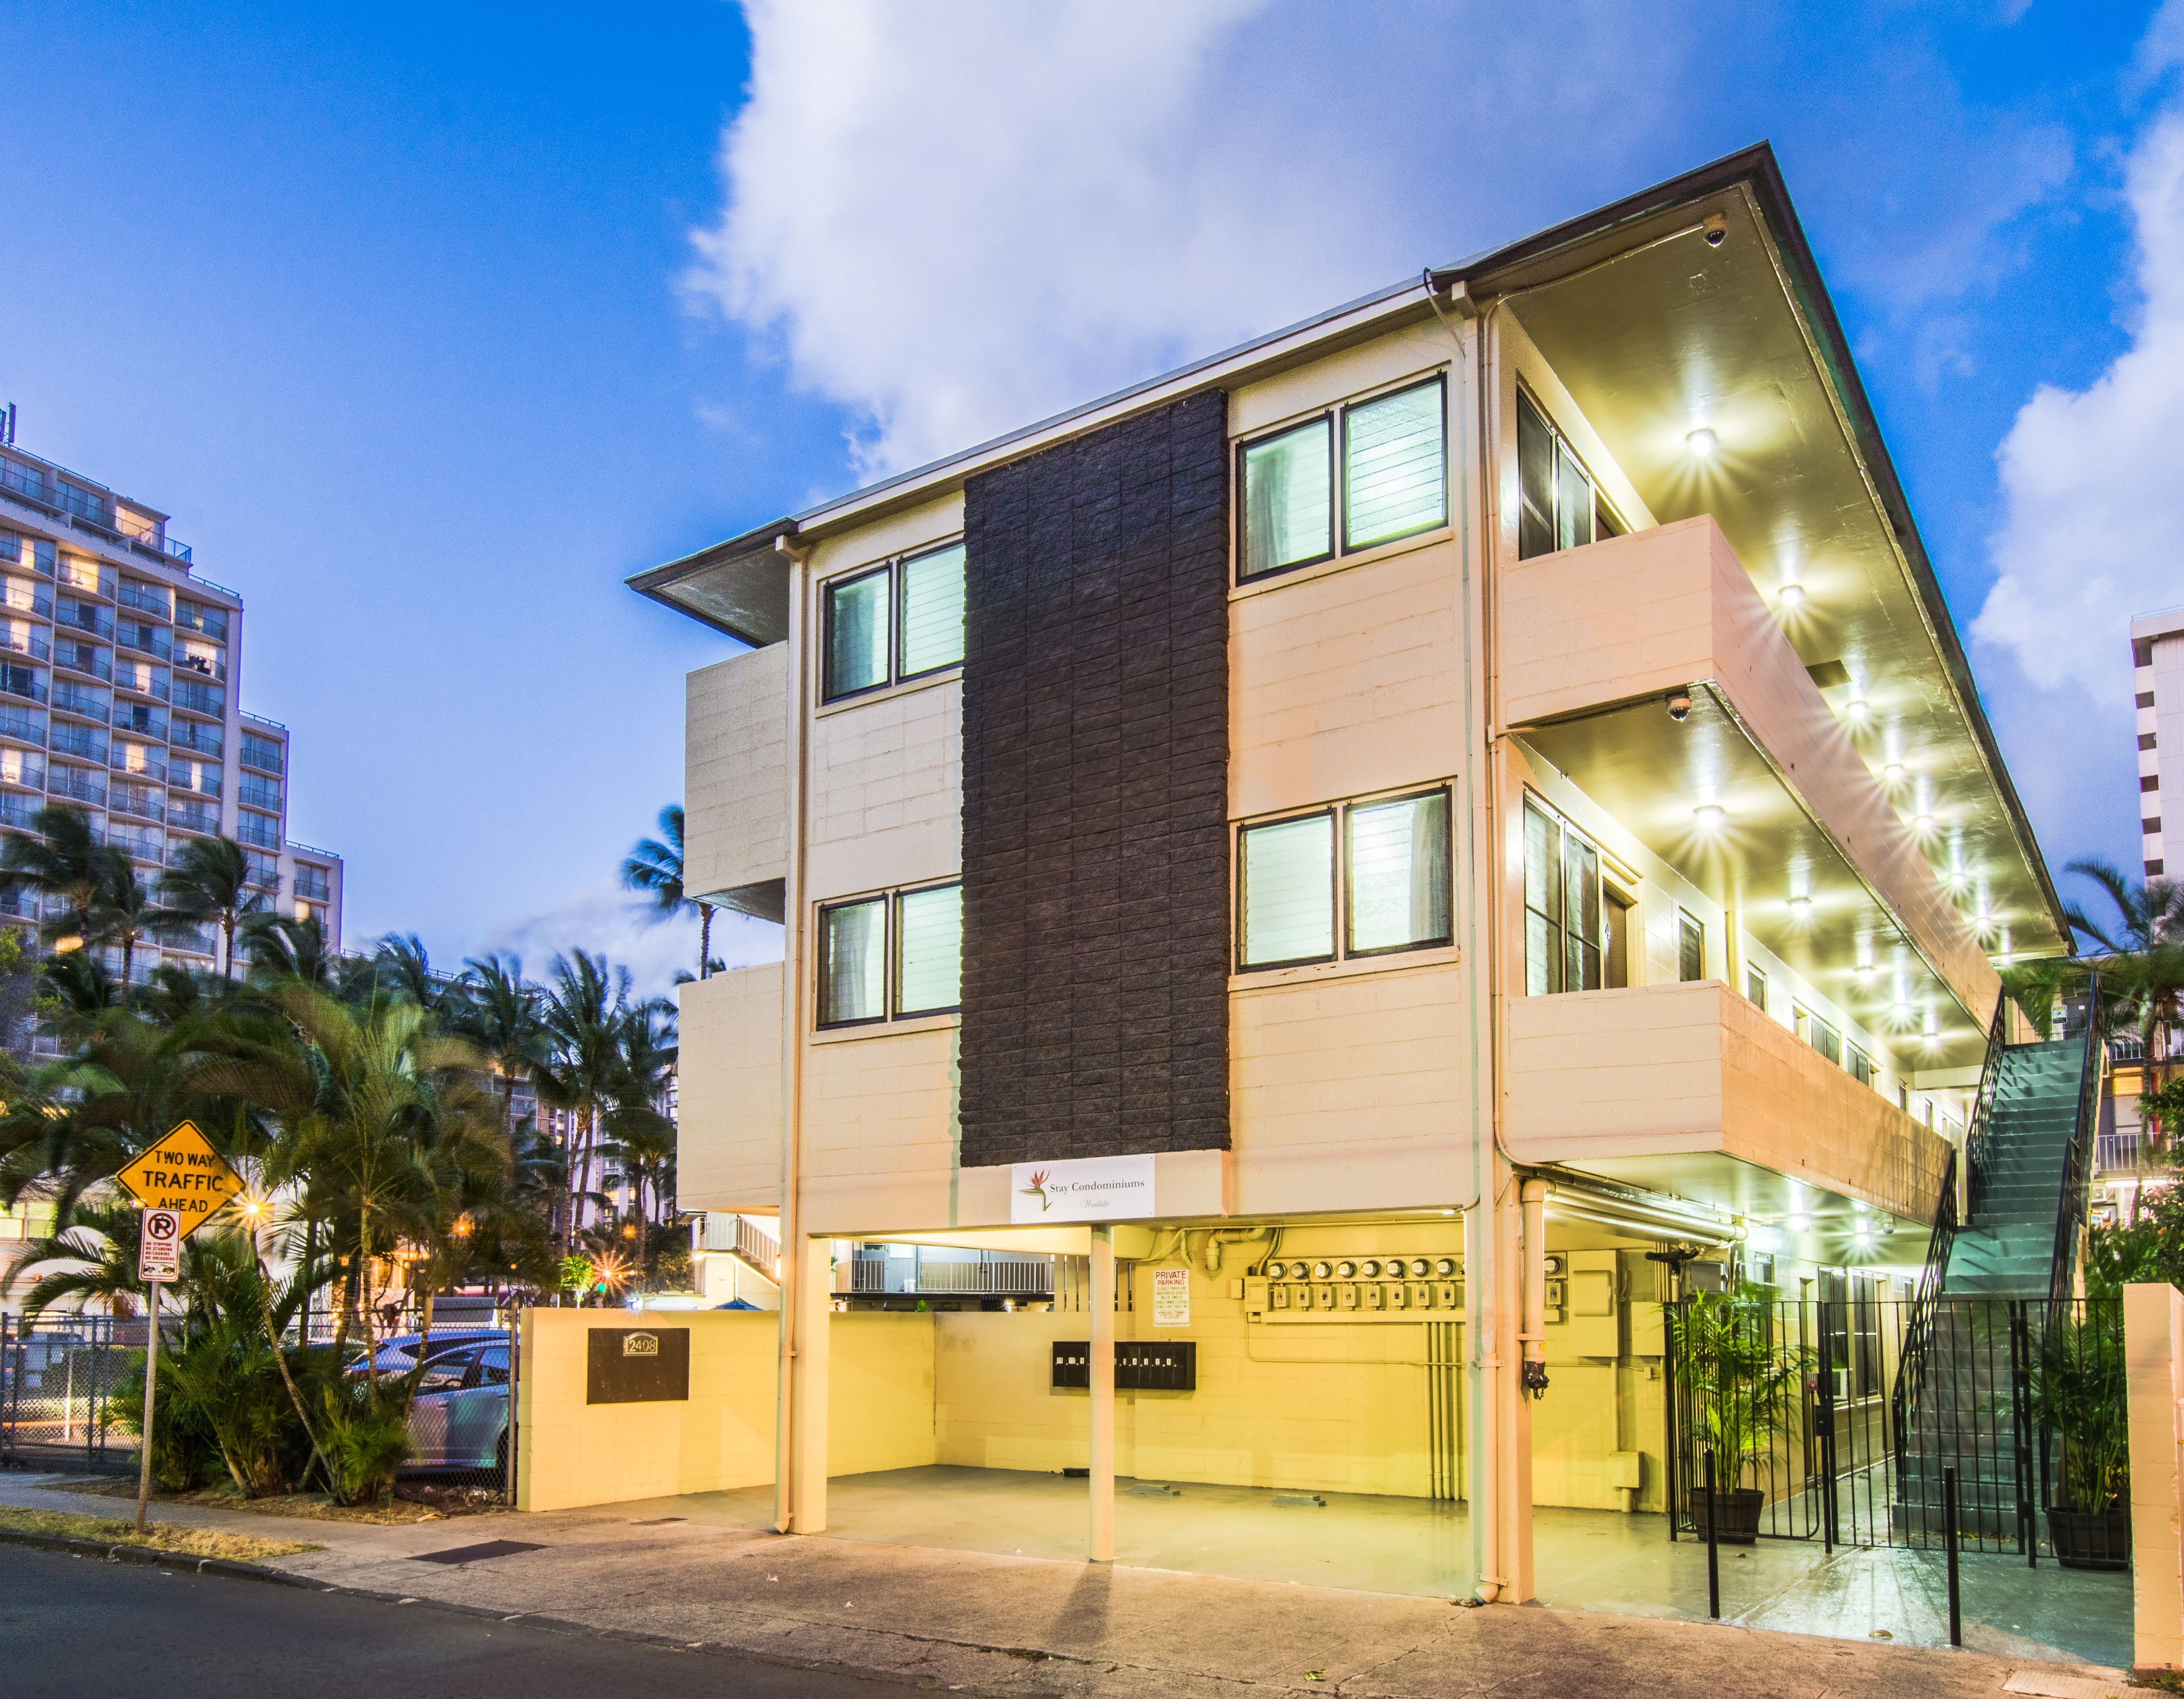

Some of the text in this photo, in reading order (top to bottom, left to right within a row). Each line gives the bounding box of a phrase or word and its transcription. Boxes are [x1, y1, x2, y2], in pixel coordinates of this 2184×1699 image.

[155, 1150, 215, 1167] TWO WAY
[142, 1169, 224, 1192] TRAFFIC
[1050, 1179, 1145, 1194] Stay Condominiums
[158, 1197, 208, 1213] AHEAD
[1156, 1271, 1186, 1279] PRIVATE
[629, 1340, 656, 1352] 2408
